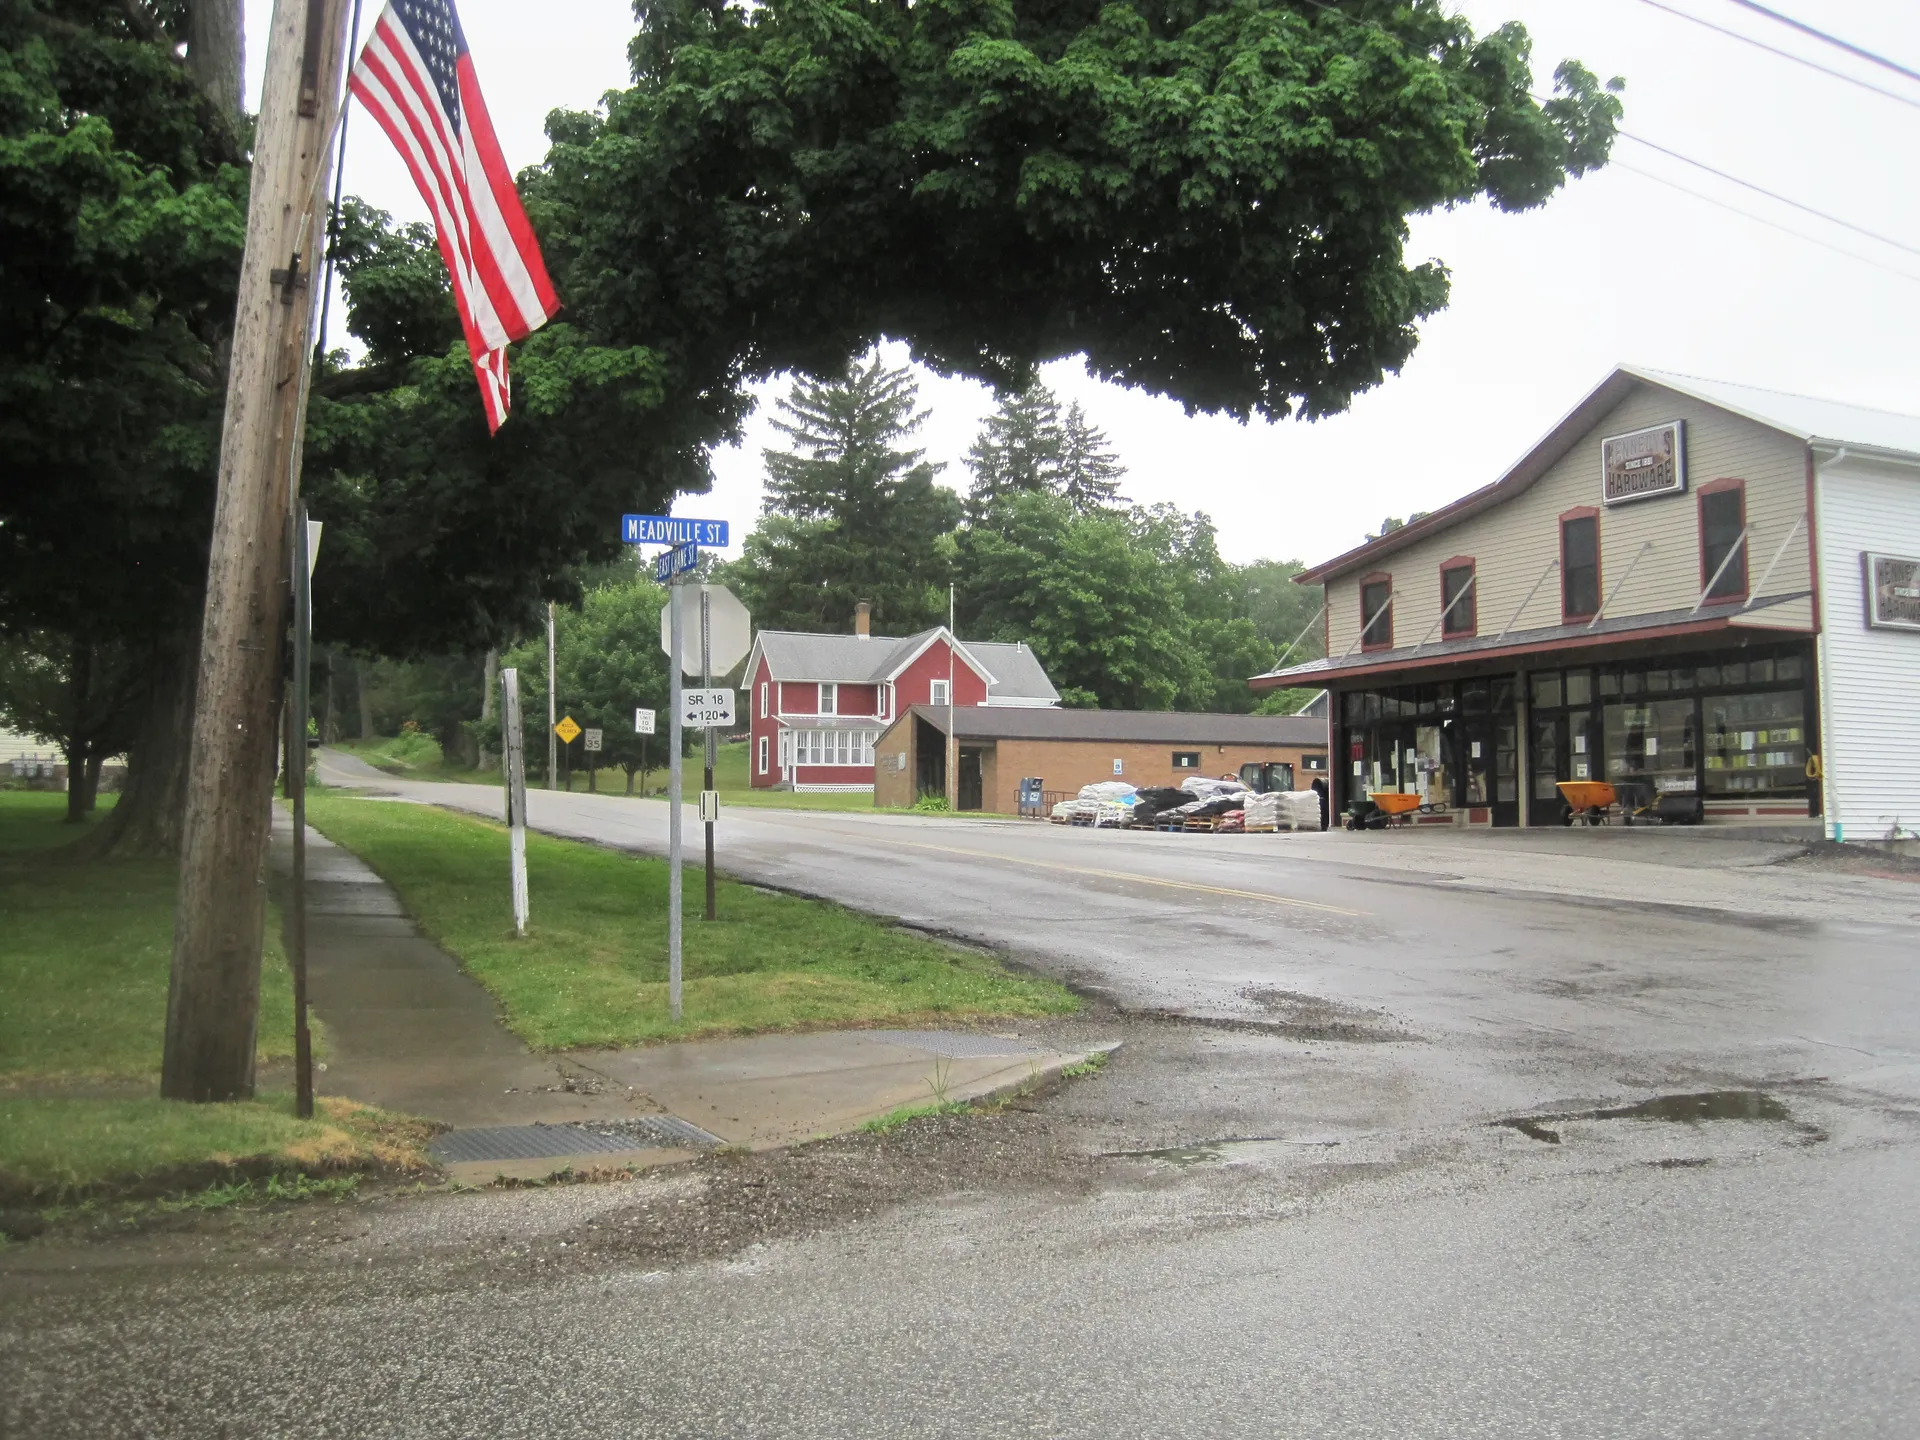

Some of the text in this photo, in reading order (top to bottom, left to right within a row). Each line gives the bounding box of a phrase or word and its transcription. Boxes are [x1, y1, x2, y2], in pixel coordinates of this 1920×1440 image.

[1607, 458, 1672, 495] HARDWARE
[628, 519, 725, 544] MEADVILLE ST.
[659, 553, 670, 577] EAST
[688, 694, 724, 706] SR 18
[699, 710, 719, 721] 120
[587, 740, 600, 748] 35
